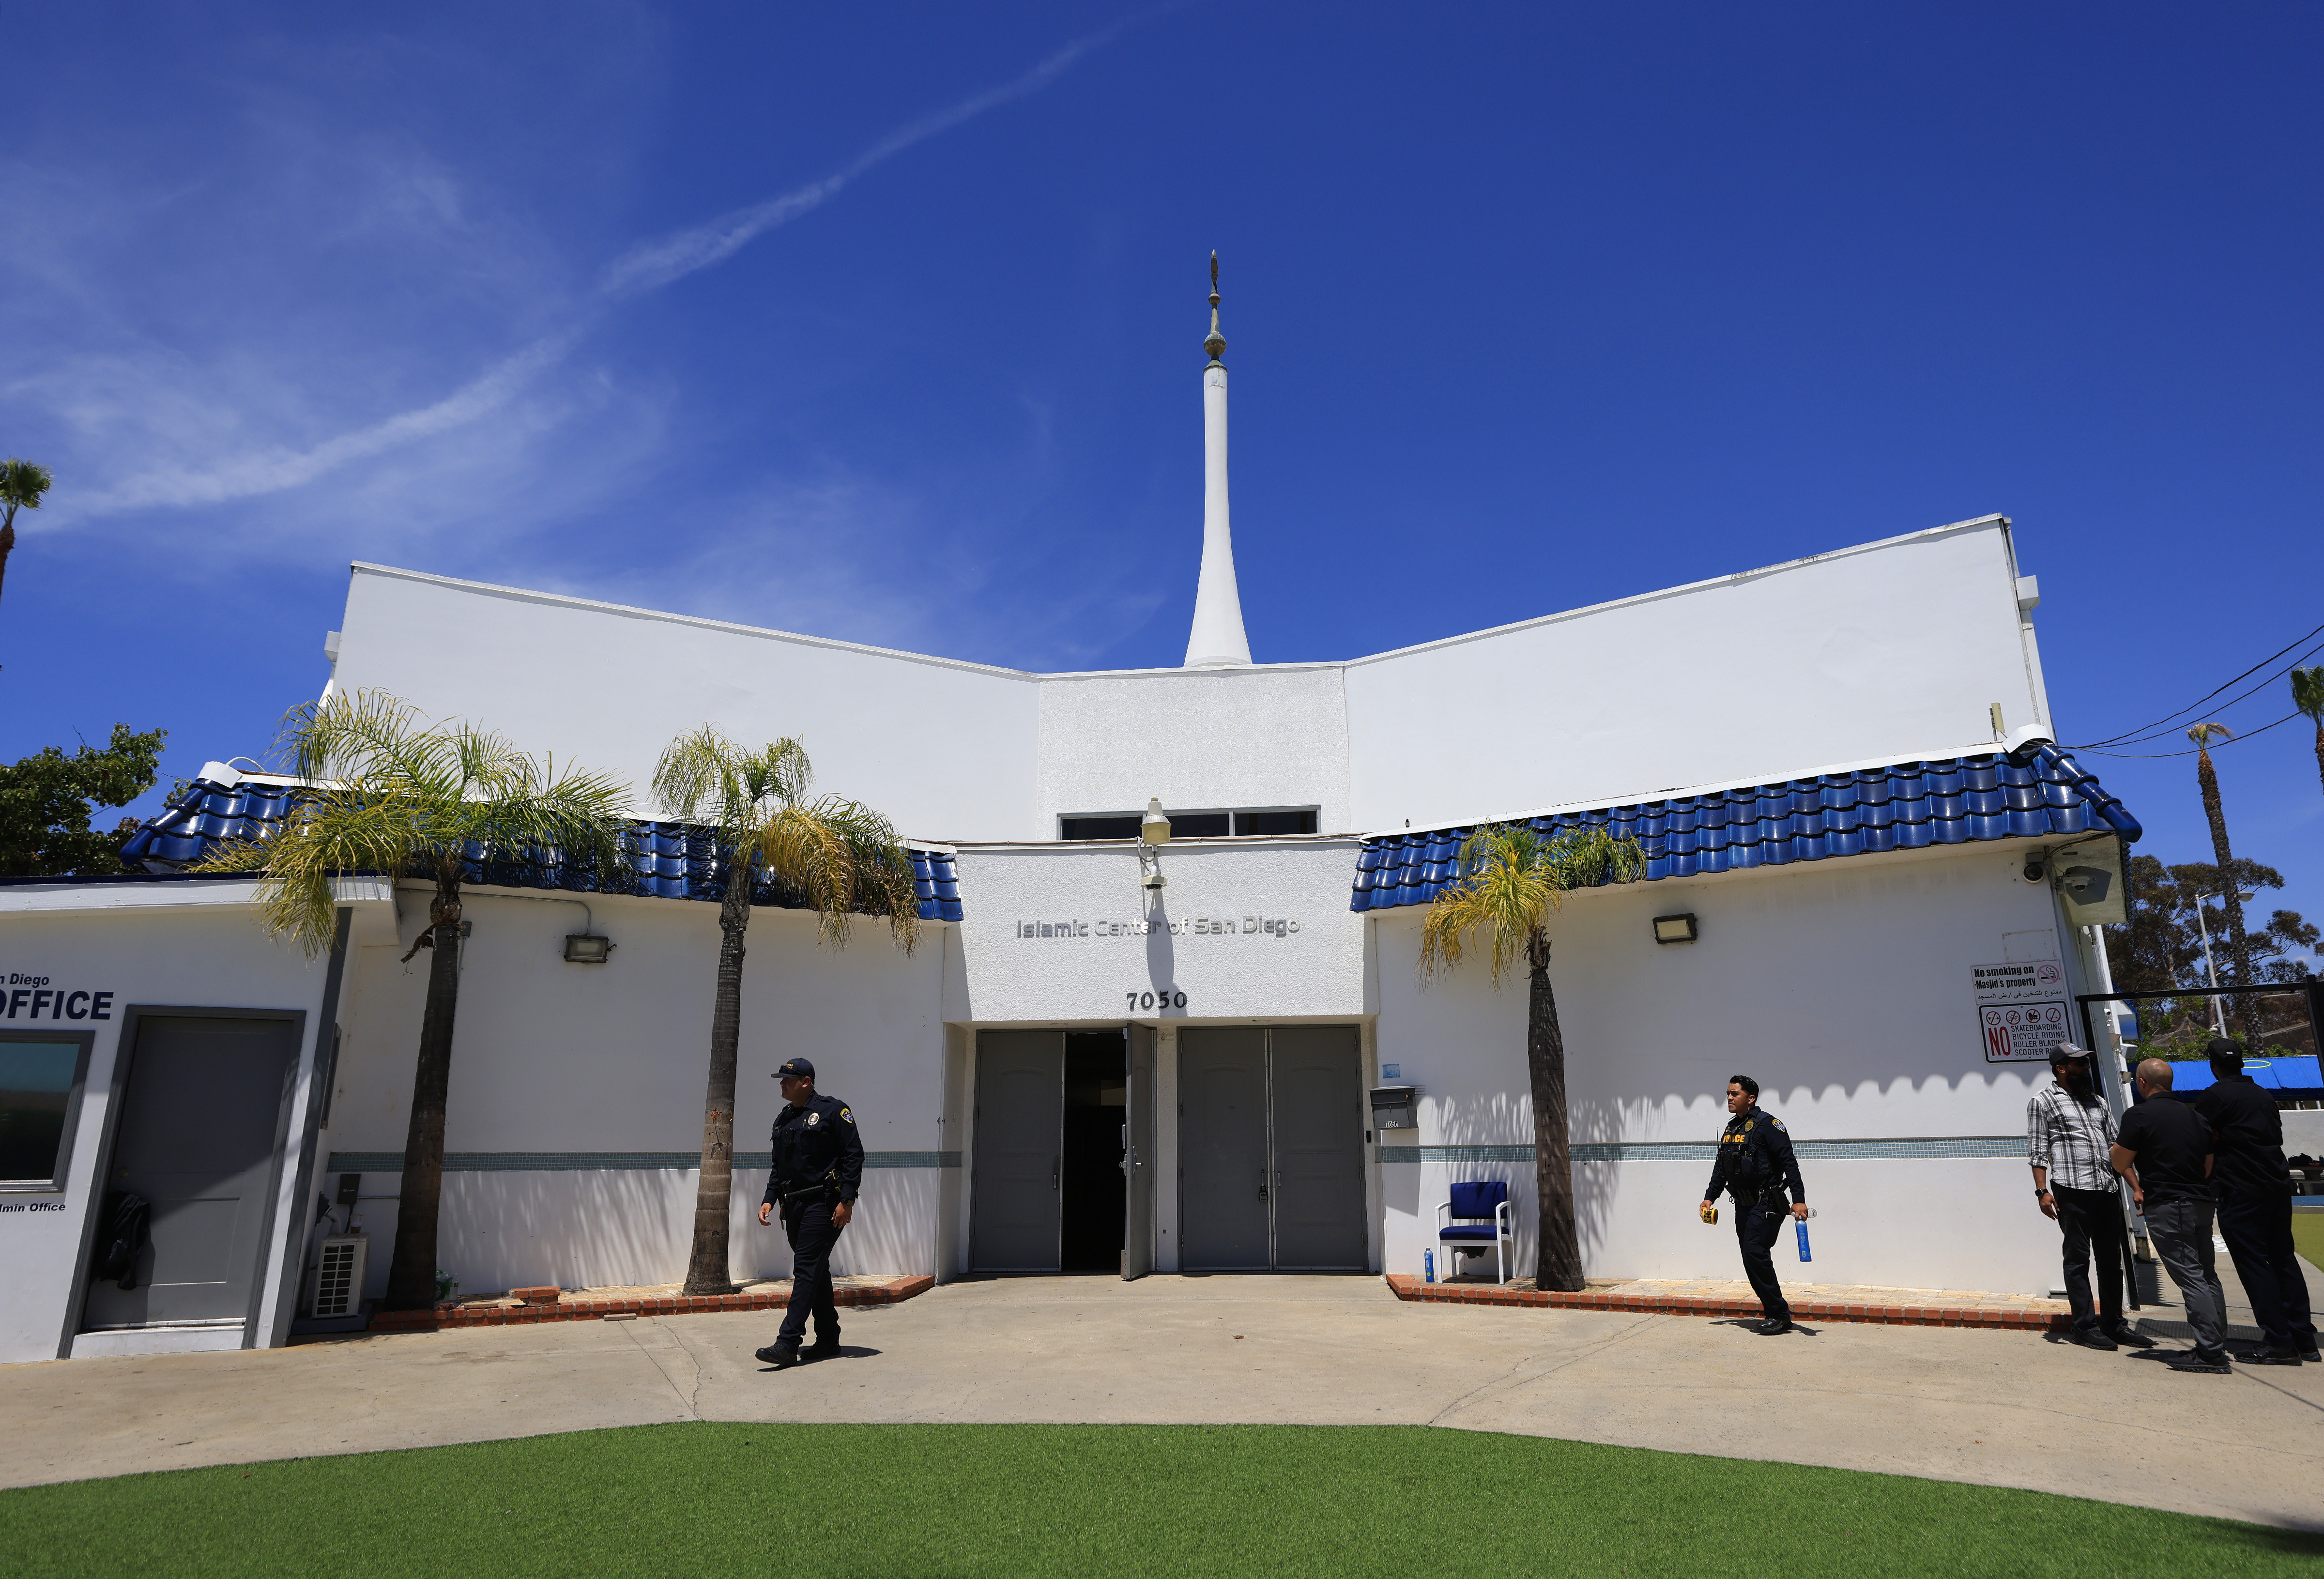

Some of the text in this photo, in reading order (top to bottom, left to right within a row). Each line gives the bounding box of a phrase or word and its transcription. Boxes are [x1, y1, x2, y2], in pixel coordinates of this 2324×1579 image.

[1017, 916, 1300, 937] Islamic Center of San Diego
[1974, 966, 2034, 978] No smoking on
[10, 973, 49, 988] Diego
[2006, 978, 2036, 988] property
[2044, 989, 2062, 997] ممنوع
[1126, 990, 1187, 1010] 7050
[2011, 1023, 2062, 1032] SKATEBOARDING
[2042, 1031, 2065, 1039] RIDING
[1988, 1026, 2011, 1056] NO
[2015, 1048, 2045, 1056] SCOOTER
[1723, 1134, 1745, 1143] POLICE
[30, 1203, 66, 1211] Office
